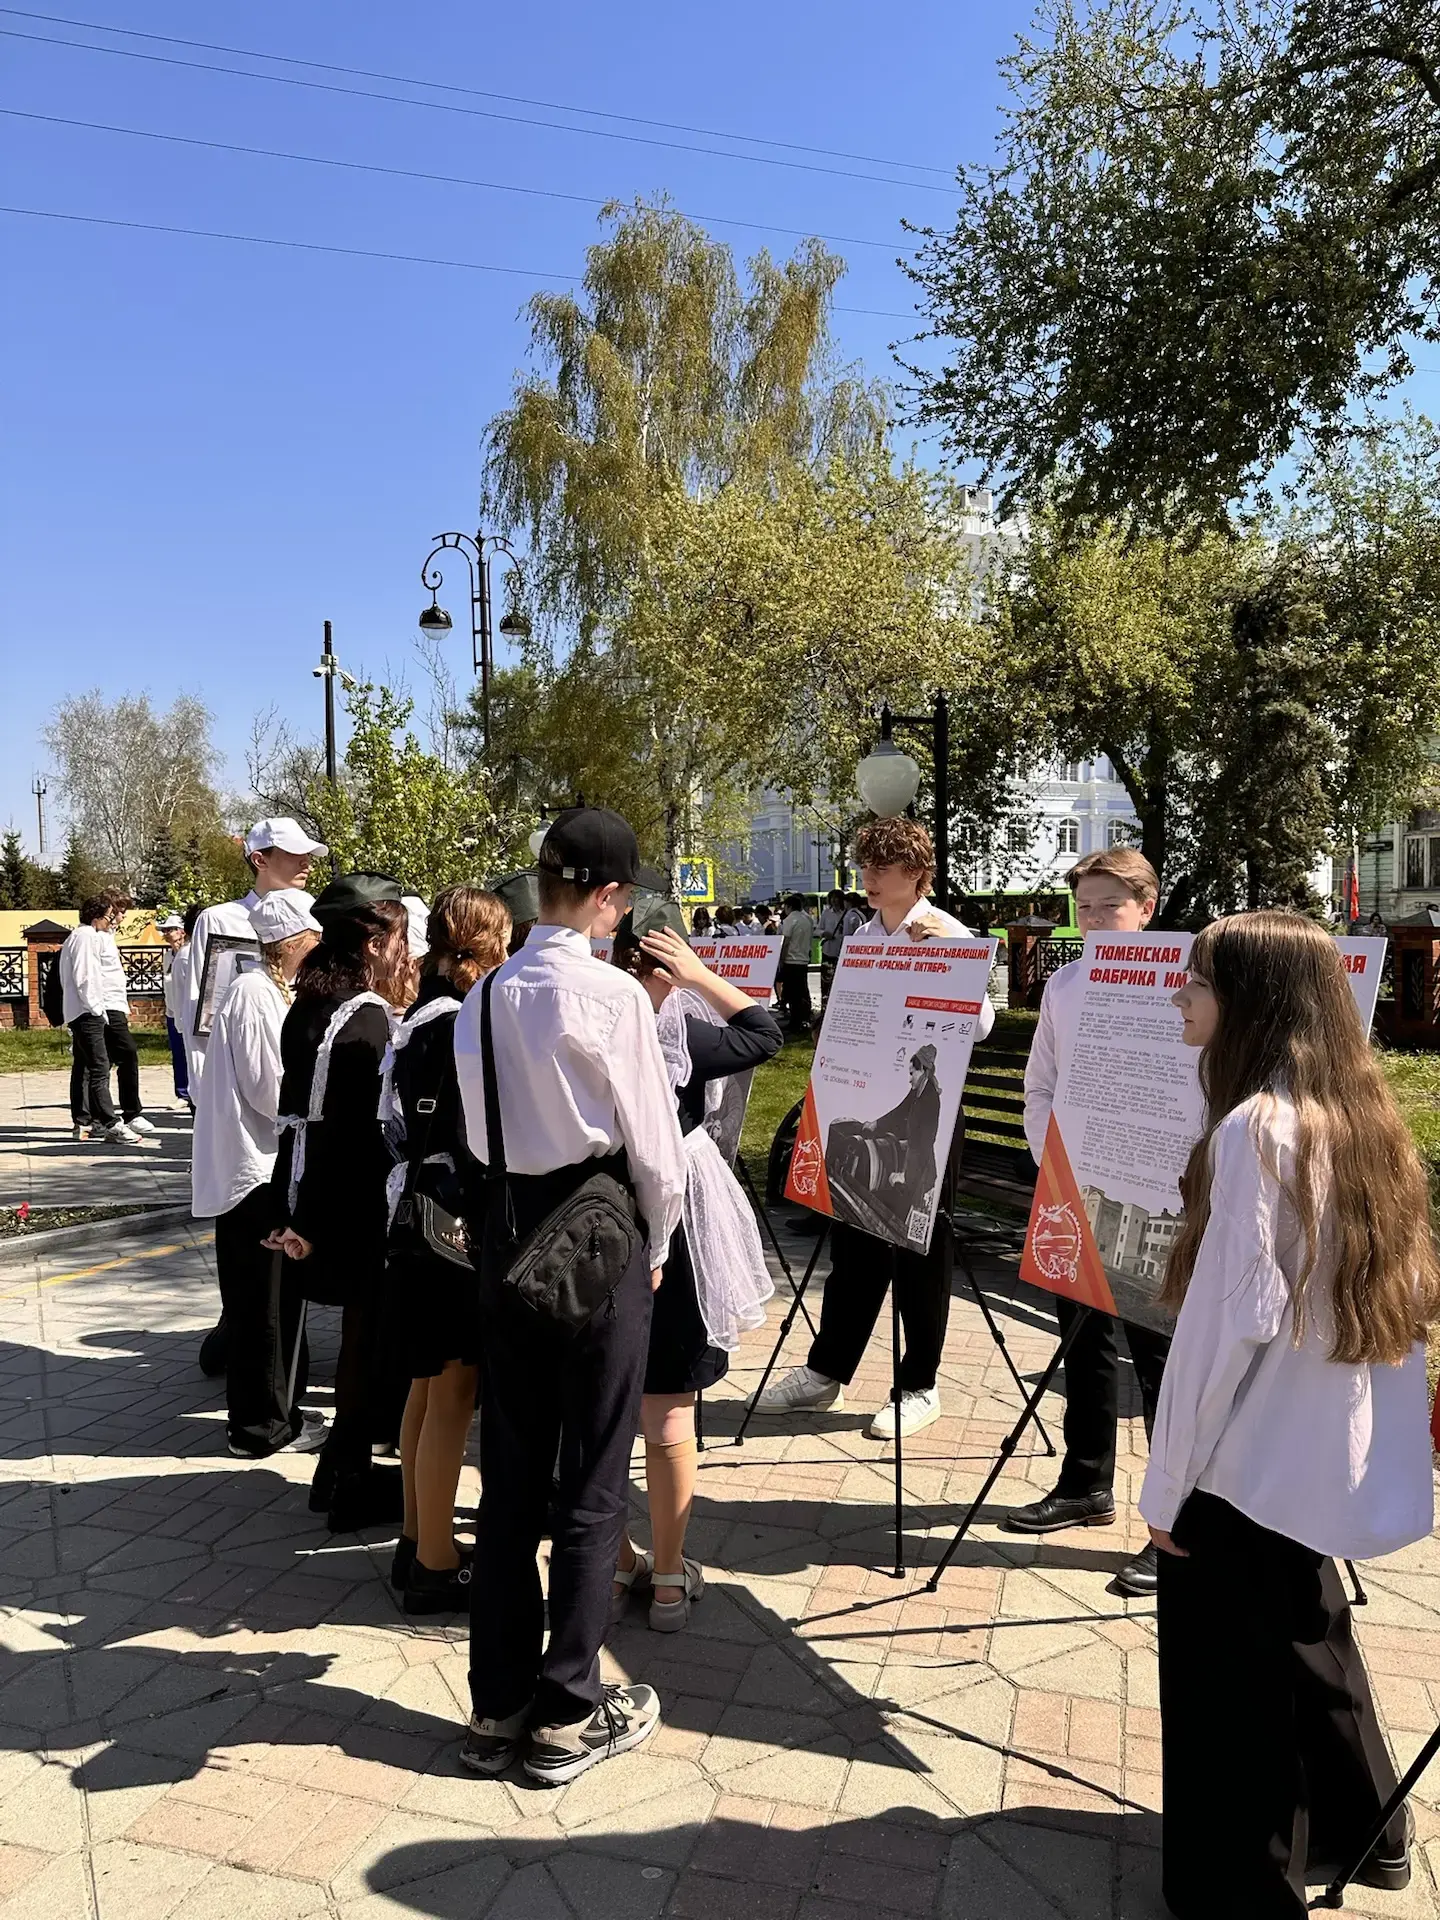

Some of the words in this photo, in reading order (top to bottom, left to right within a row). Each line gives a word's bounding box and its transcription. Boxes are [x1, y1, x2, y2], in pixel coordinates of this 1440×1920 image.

[719, 945, 773, 959] ГАЛЬВАНО-
[845, 943, 884, 955] ТЮМЕНСКИЙ
[886, 946, 989, 960] ДЕРЕВООБРАБАТЫВАЮЩИЙ
[1095, 945, 1182, 963] ТЮМЕНСКАЯ
[719, 964, 750, 978] ЗАВОД
[842, 958, 875, 969] КОМБИНАТ
[876, 958, 912, 972] «КРАСНЫЙ
[914, 961, 952, 973] ОКТЯБРЬ»
[1089, 968, 1156, 987] ФАБРИКА
[853, 1079, 866, 1089] 1933
